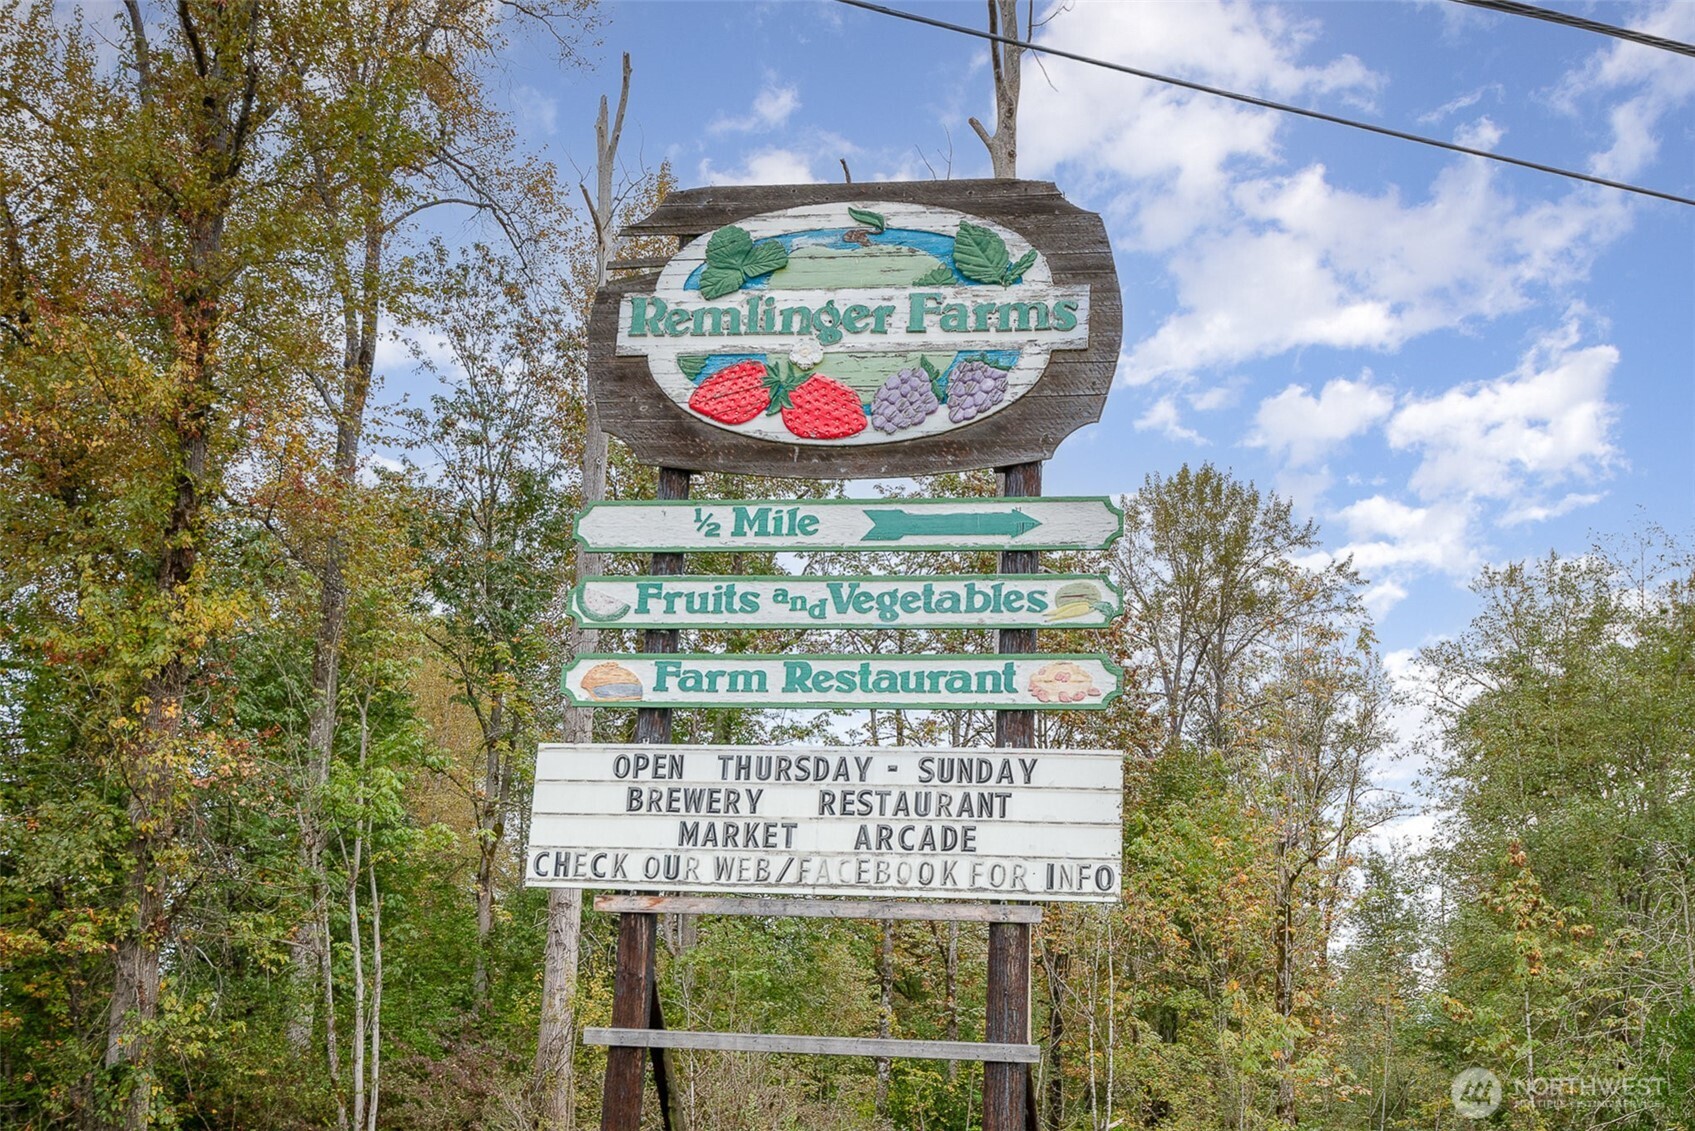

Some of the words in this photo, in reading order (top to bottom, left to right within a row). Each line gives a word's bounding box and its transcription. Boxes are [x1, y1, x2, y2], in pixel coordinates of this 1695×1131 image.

[628, 295, 896, 346] Remlinger
[906, 292, 1079, 334] Farms
[730, 506, 820, 537] Mile
[633, 582, 760, 615] Fruits
[772, 587, 827, 620] and
[826, 581, 1049, 622] Vegetables
[652, 660, 769, 693] Farm
[781, 660, 1019, 695] Restaurant
[612, 753, 684, 780] OPEN
[717, 754, 873, 783] THURSDAY
[918, 757, 1039, 785] SUNDAY
[625, 786, 764, 815] BREWERY
[817, 788, 1013, 820] RESTAURANT
[678, 820, 798, 849] MARKET
[854, 824, 977, 853] ARCADE
[532, 851, 628, 879] CHECK
[642, 854, 700, 882] OUR
[713, 855, 959, 888] WEB/FACEBOOK
[967, 860, 1028, 889] FOR
[1045, 861, 1116, 892] INFO
